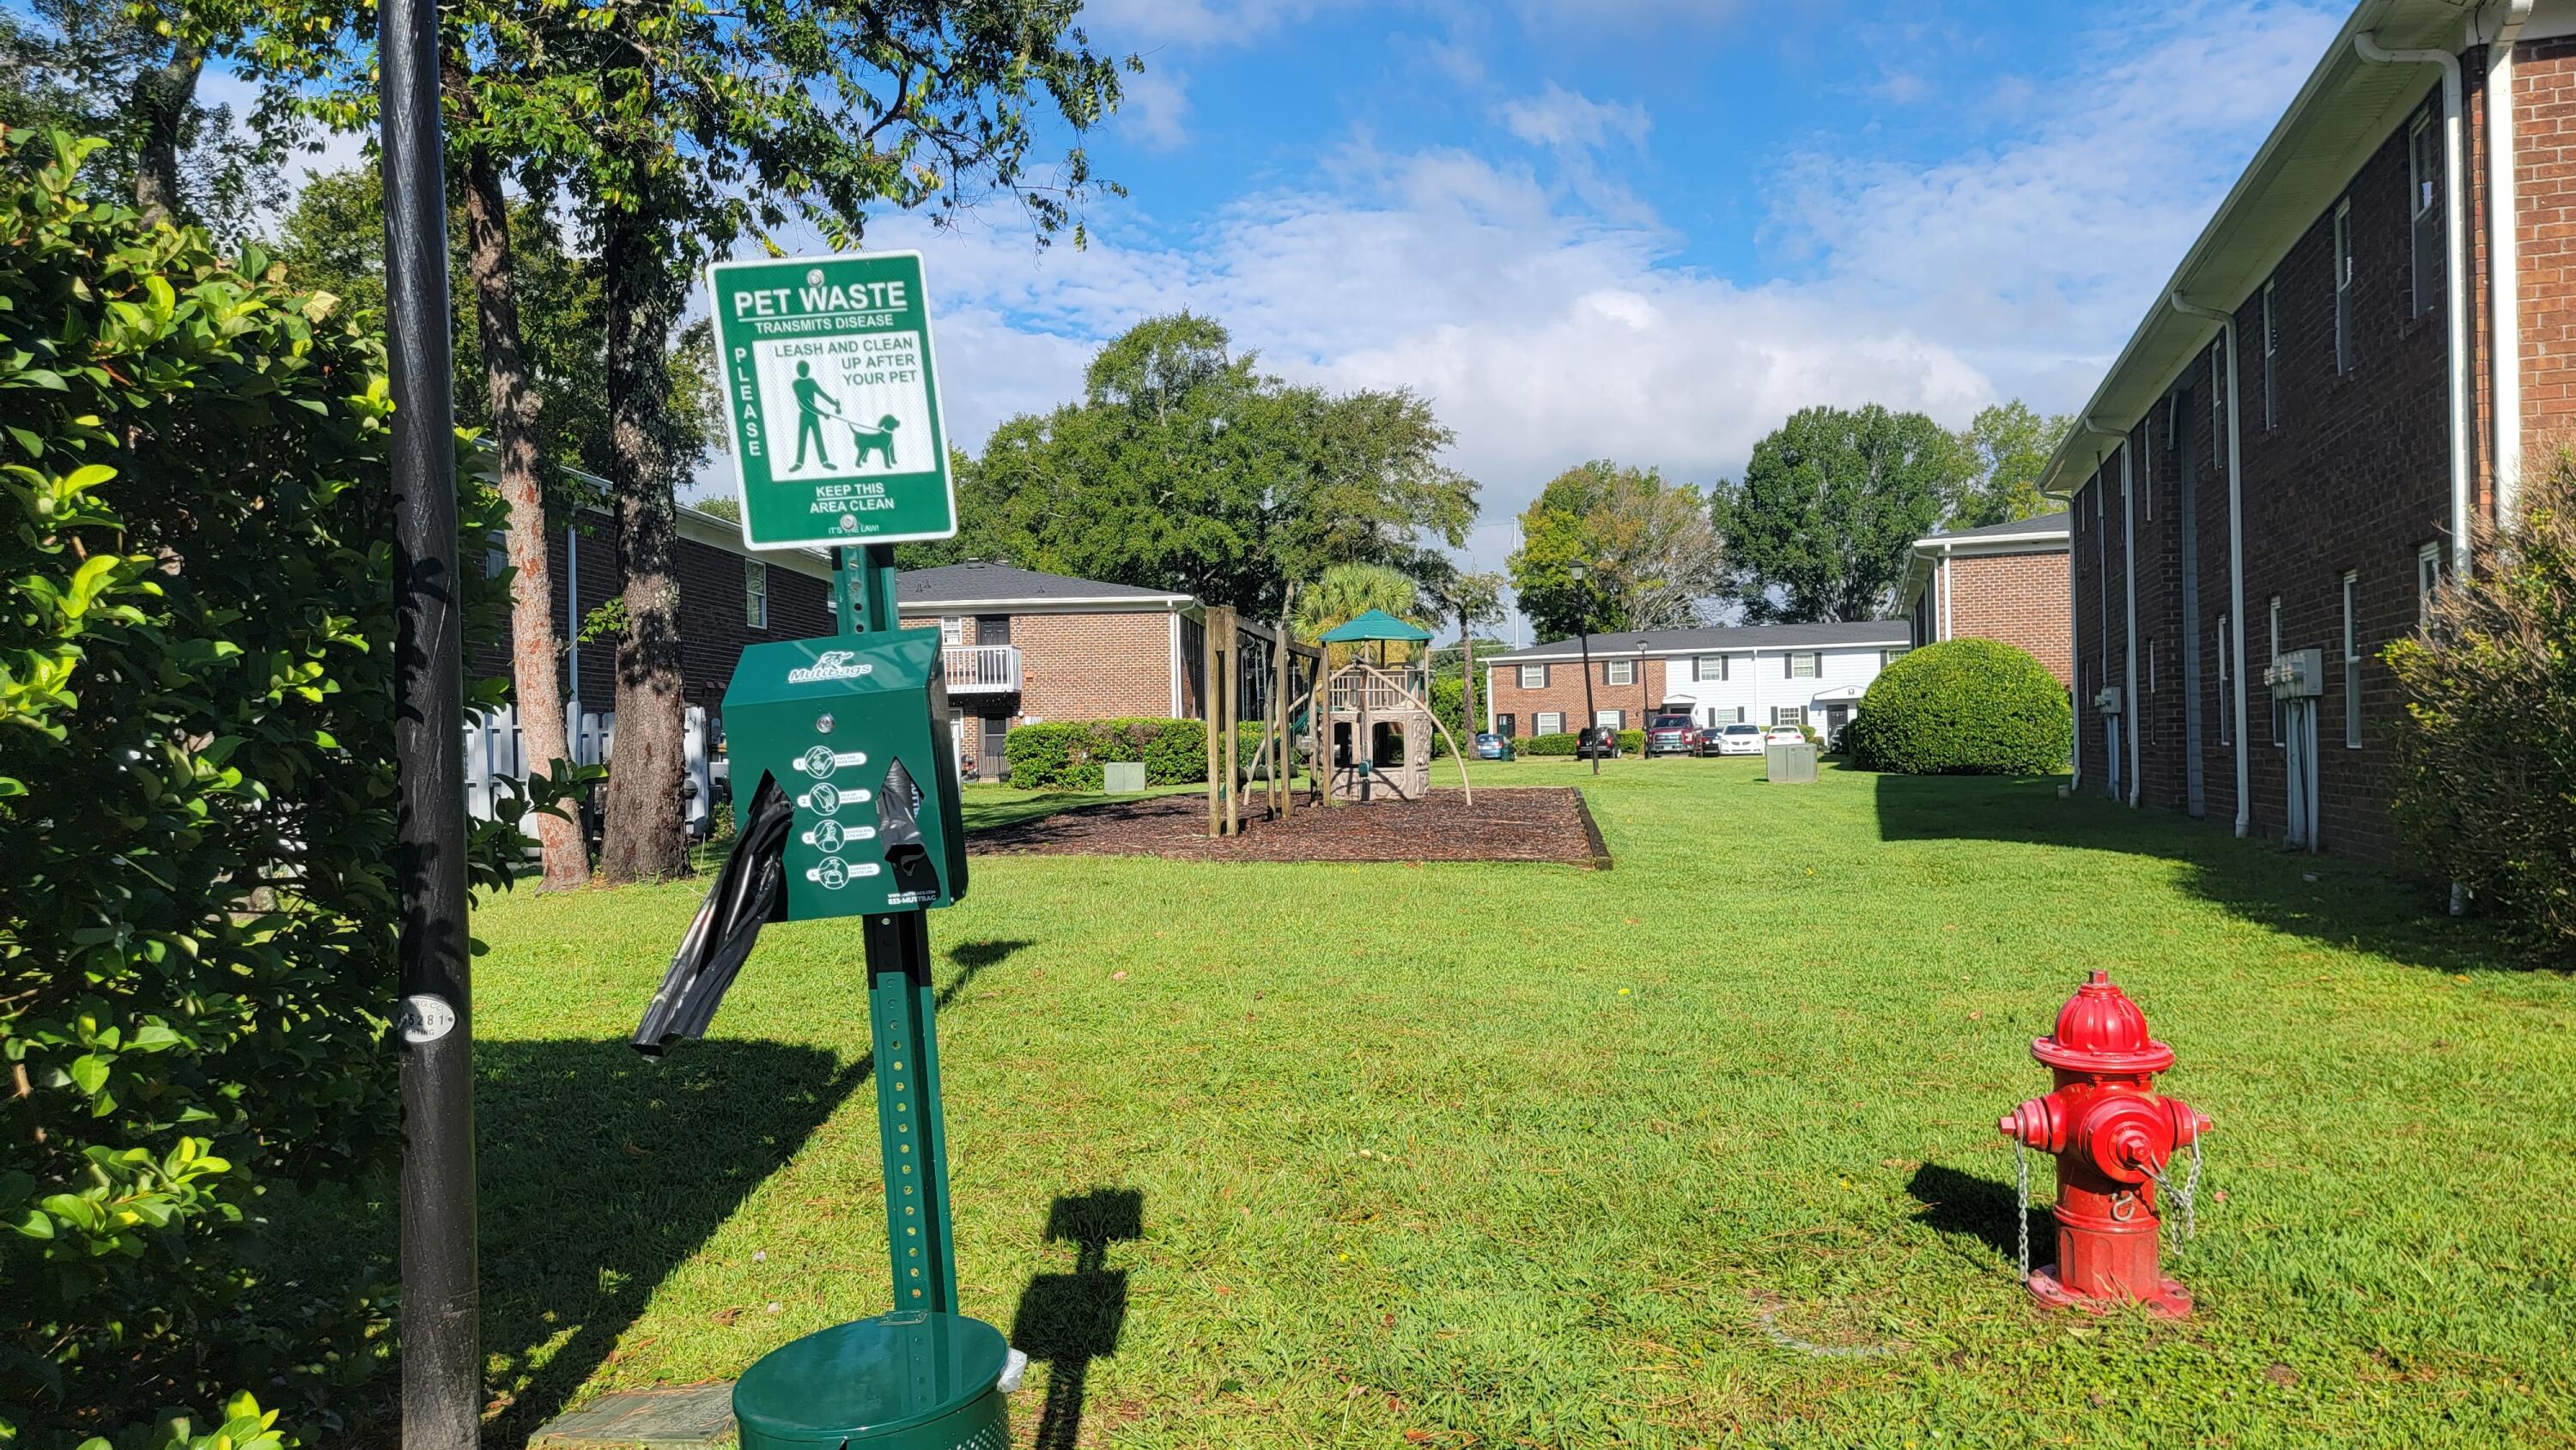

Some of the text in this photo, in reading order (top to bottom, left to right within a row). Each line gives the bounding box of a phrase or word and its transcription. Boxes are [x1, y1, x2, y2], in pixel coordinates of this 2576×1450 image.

[734, 281, 908, 317] PET WASTE
[755, 314, 894, 334] TRANSMITS DISEASE
[775, 337, 914, 358] LEASH AND CLEAN
[841, 354, 916, 370] UP AFTER
[842, 370, 917, 386] YOUR PET
[734, 347, 762, 457] PLEASE
[816, 482, 884, 497] KEEP THIS
[810, 498, 895, 513] AREA CLEAN
